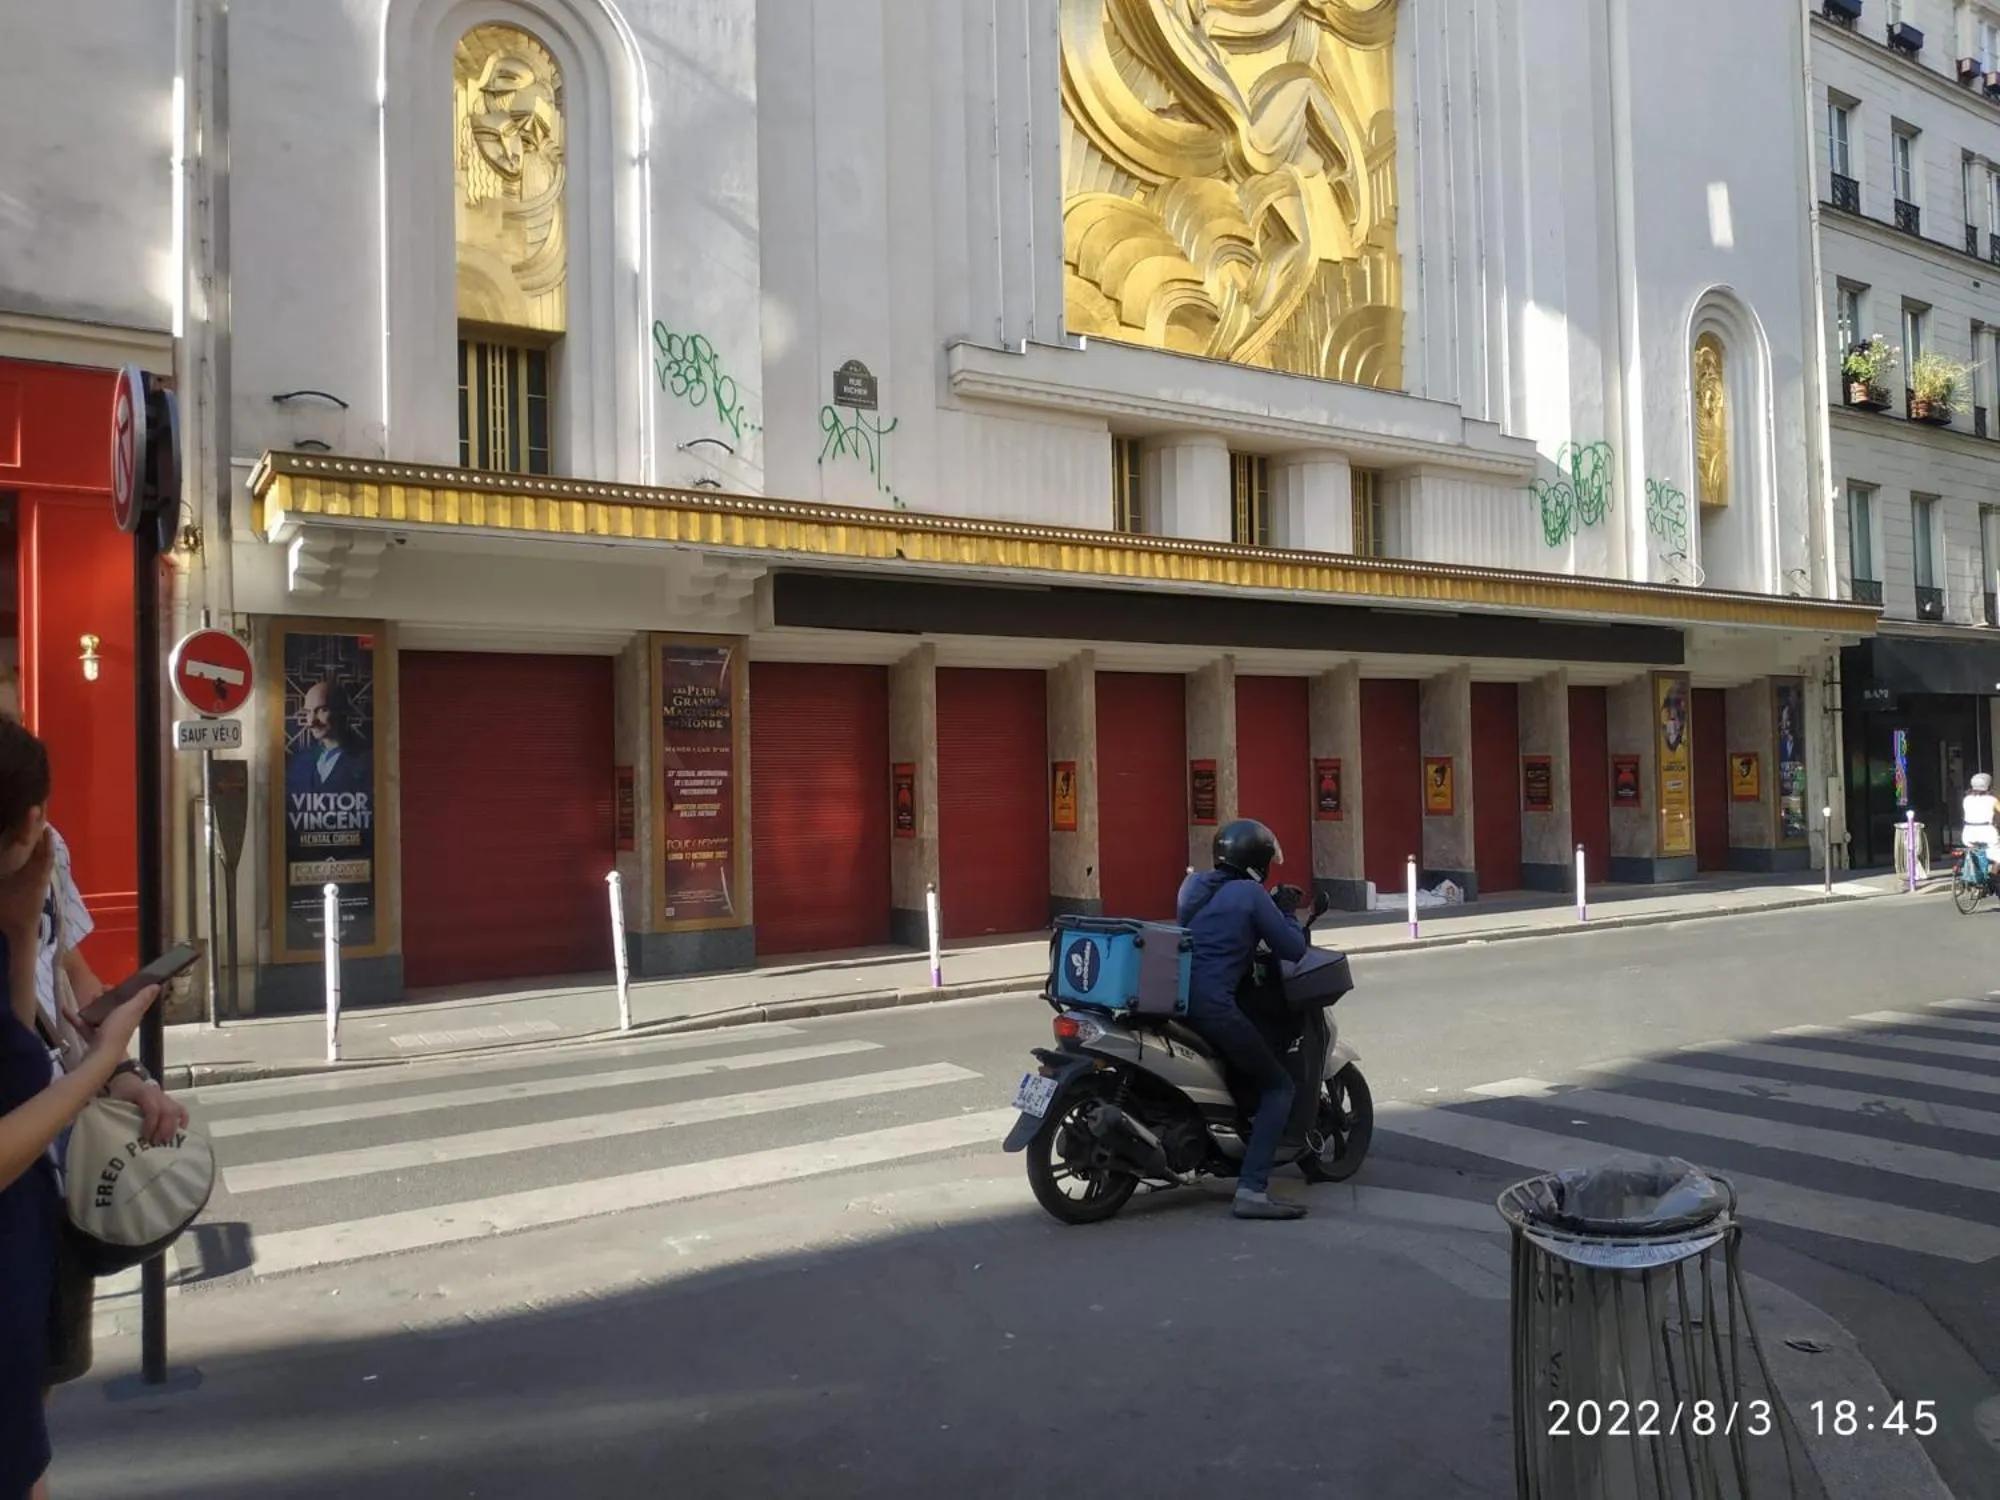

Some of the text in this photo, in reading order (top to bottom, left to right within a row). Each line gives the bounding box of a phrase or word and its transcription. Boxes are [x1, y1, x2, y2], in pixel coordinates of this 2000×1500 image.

[687, 685, 716, 696] PLUS
[180, 727, 208, 743] SAUF
[291, 791, 368, 811] VIKTOR
[288, 811, 373, 831] VINCENT
[95, 1157, 125, 1208] FRED
